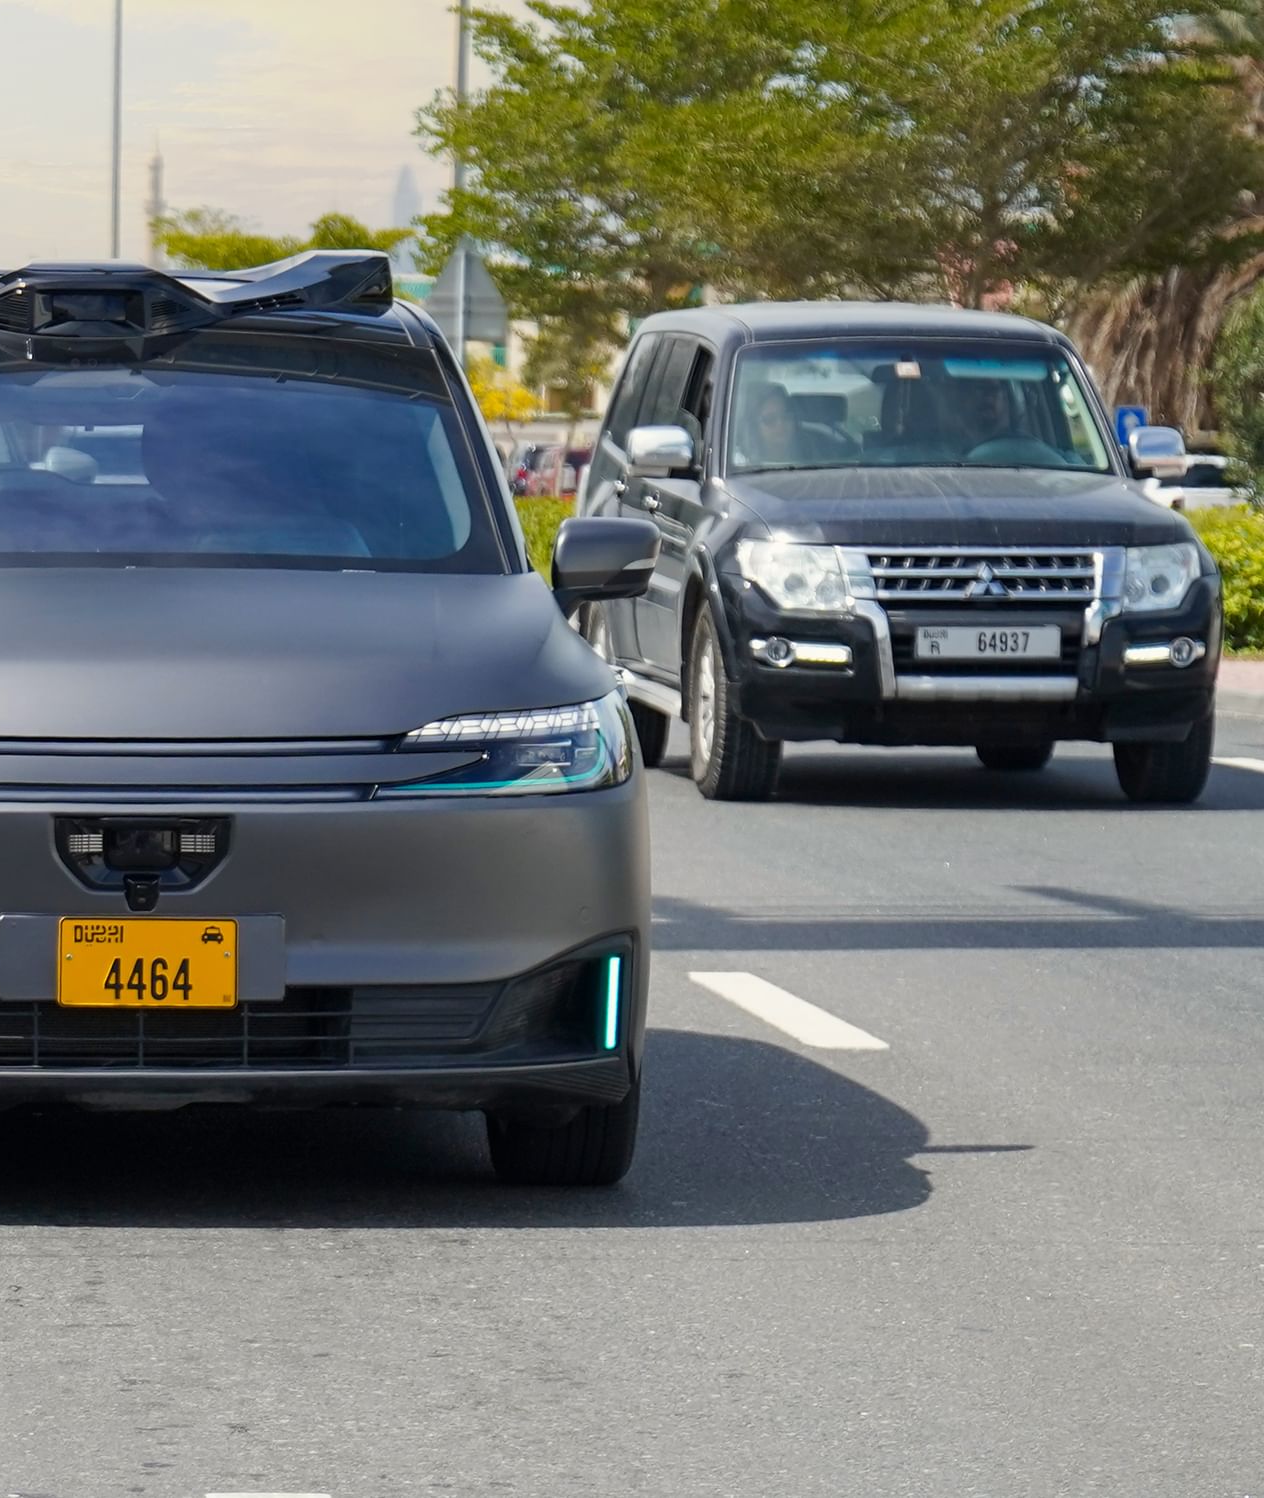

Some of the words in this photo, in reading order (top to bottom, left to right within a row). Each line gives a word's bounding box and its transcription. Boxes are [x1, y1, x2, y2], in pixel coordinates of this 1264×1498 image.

[930, 640, 941, 655] R
[978, 631, 1030, 653] 64937
[103, 957, 193, 1001] 4464
